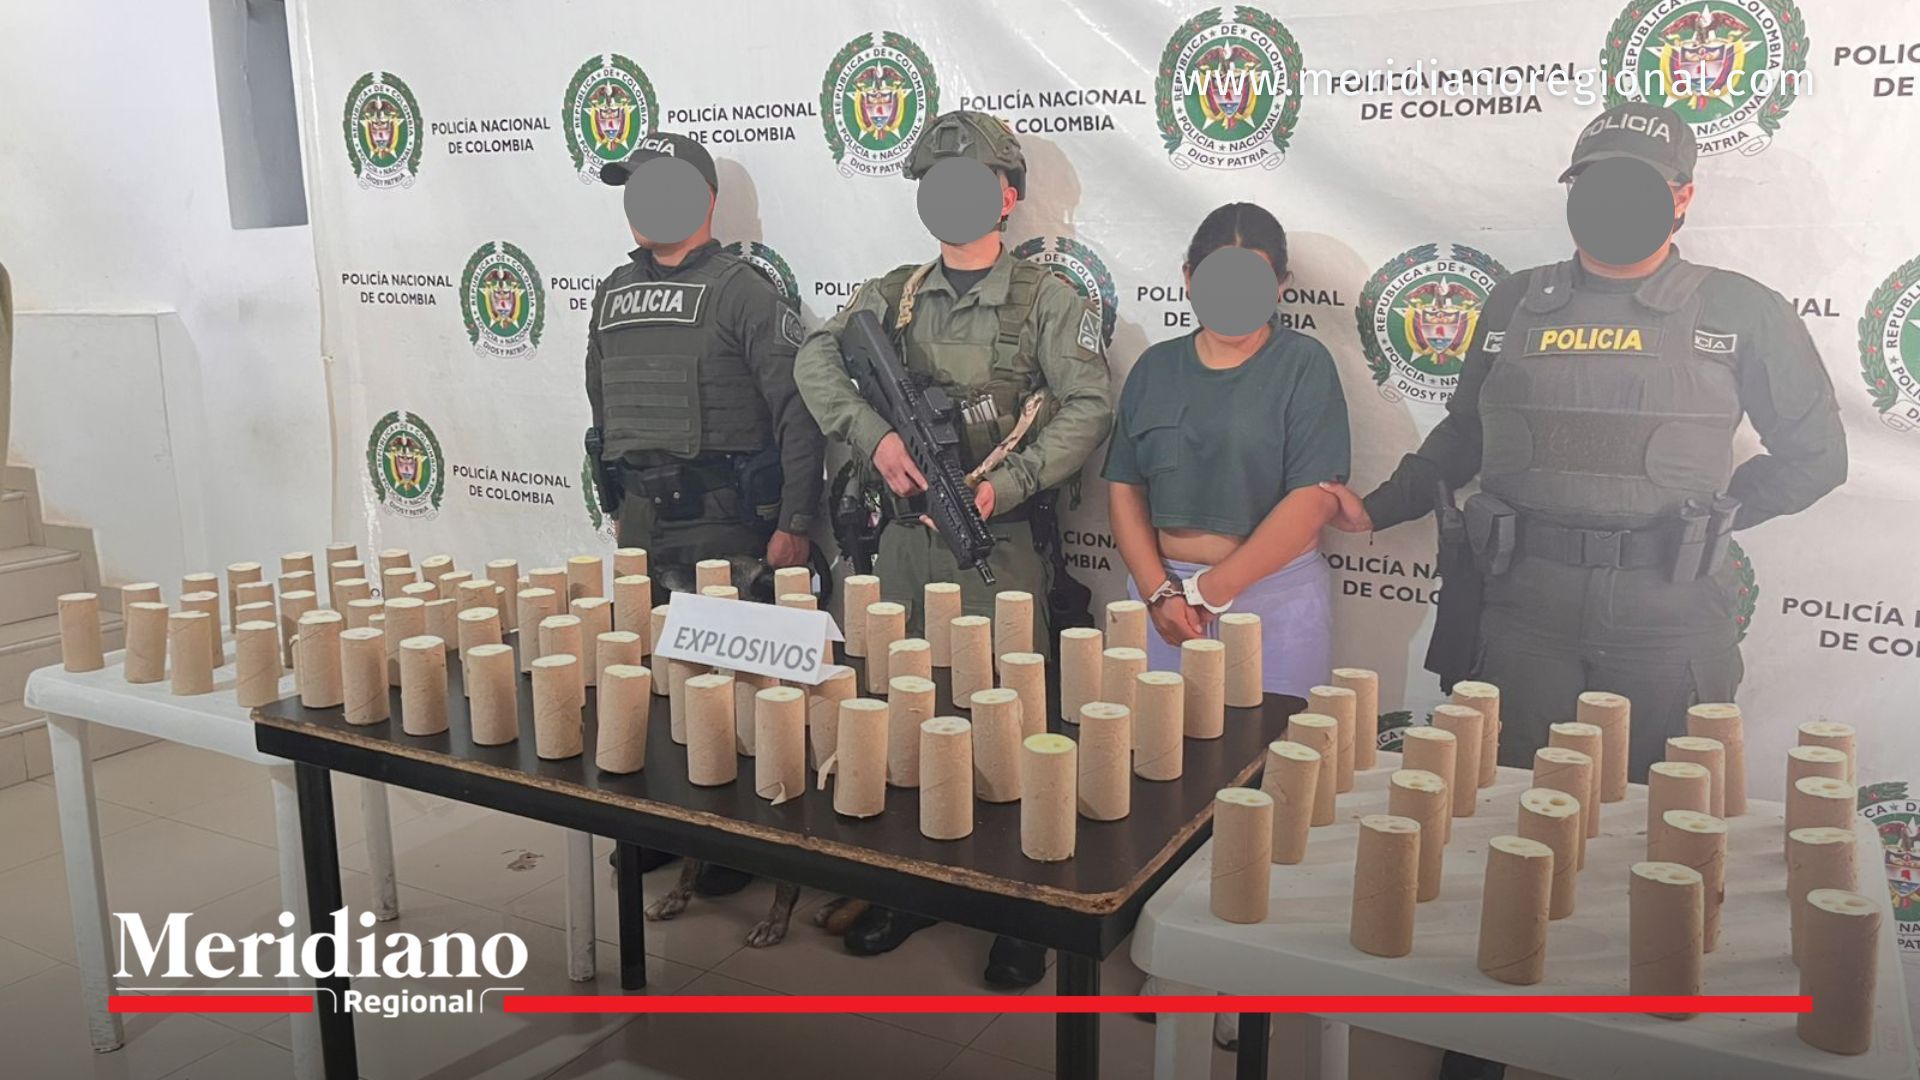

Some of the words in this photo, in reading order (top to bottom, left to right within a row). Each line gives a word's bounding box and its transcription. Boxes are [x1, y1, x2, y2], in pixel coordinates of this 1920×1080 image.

[1220, 25, 1238, 35] DE
[603, 69, 615, 77] DE
[835, 56, 864, 115] REPUBLICA
[873, 48, 887, 57] DE
[895, 53, 925, 111] COLOMBIA
[1873, 76, 1914, 97] DE
[960, 89, 1035, 112] POLICÍA
[1039, 89, 1147, 109] NACIONAL
[1361, 102, 1393, 120] DE
[1400, 95, 1542, 119] COLOMBIA
[668, 103, 728, 124] POLICÍA
[732, 102, 817, 121] NACIONAL
[1697, 94, 1767, 136] NACIONA
[432, 117, 478, 135] POLICÍA
[481, 117, 551, 133] NACIONAL
[1015, 114, 1115, 134] COLOMBIA
[1178, 116, 1215, 150] POLICIA
[1229, 111, 1280, 152] NACIONAL
[689, 130, 708, 144] DE
[712, 126, 796, 143] COLOMBIA
[448, 141, 463, 154] DE
[465, 138, 534, 154] COLOMBIA
[1227, 148, 1269, 167] PATRIA
[342, 270, 389, 286] POLICÍA
[391, 274, 453, 288] NACIONAL
[360, 291, 375, 304] DE
[377, 292, 436, 306] COLOMBIA
[569, 298, 587, 310] DE
[610, 289, 684, 319] POLICIA
[1137, 286, 1190, 302] POLI
[1376, 268, 1423, 332] REPUBLICA
[1438, 262, 1457, 272] DE
[1164, 311, 1190, 328] DE
[1539, 328, 1643, 351] POLICIA
[1384, 346, 1426, 383] POLICIA
[452, 465, 498, 480] POLICÍA
[501, 470, 571, 488] NACIONAL
[469, 484, 483, 498] DE
[486, 487, 554, 505] COLOMBIA
[1063, 530, 1117, 549] CION
[1321, 553, 1405, 576] OLICÍA
[1343, 579, 1372, 598] DE
[1782, 597, 1905, 627] POLICÍA
[673, 626, 818, 673] EXPLOSIVOS
[1819, 630, 1860, 651] DE
